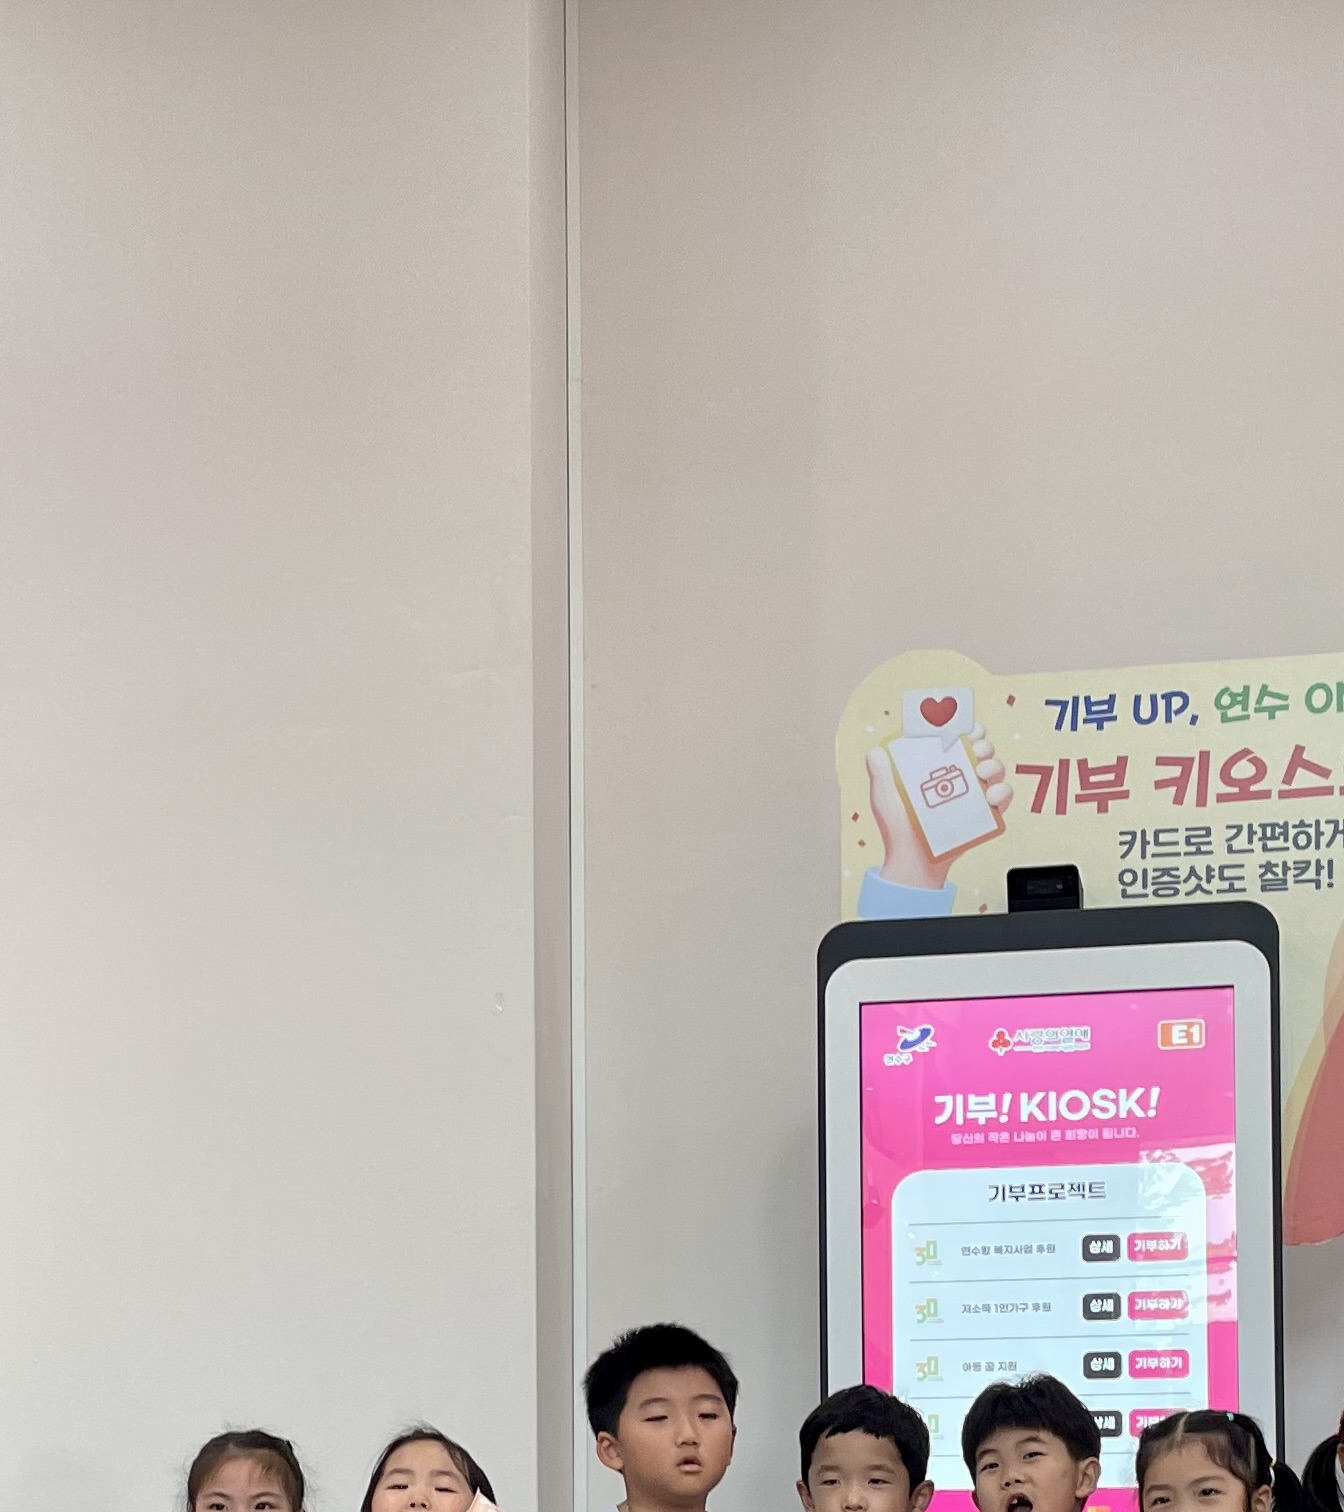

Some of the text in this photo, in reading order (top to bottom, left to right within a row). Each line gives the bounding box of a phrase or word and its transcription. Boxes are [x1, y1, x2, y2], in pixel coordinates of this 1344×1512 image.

[1044, 694, 1118, 731] 기부
[1132, 690, 1199, 726] UP,
[1214, 683, 1290, 724] 연수
[1014, 755, 1130, 815] 기부
[1118, 825, 1214, 860] 카드로
[1118, 858, 1335, 899] 인증샷도 찰칵!
[1172, 1023, 1201, 1045] E1
[933, 1087, 1161, 1125] 기부! KIOSK!
[988, 1181, 1107, 1203] 기부프로젝트
[1089, 1240, 1114, 1255] 상세
[1134, 1239, 1182, 1252] 기부하기
[1090, 1298, 1114, 1313] 상세
[1134, 1298, 1183, 1311] 기부하기
[1090, 1358, 1115, 1371] 상세
[1135, 1356, 1183, 1369] 기부하기
